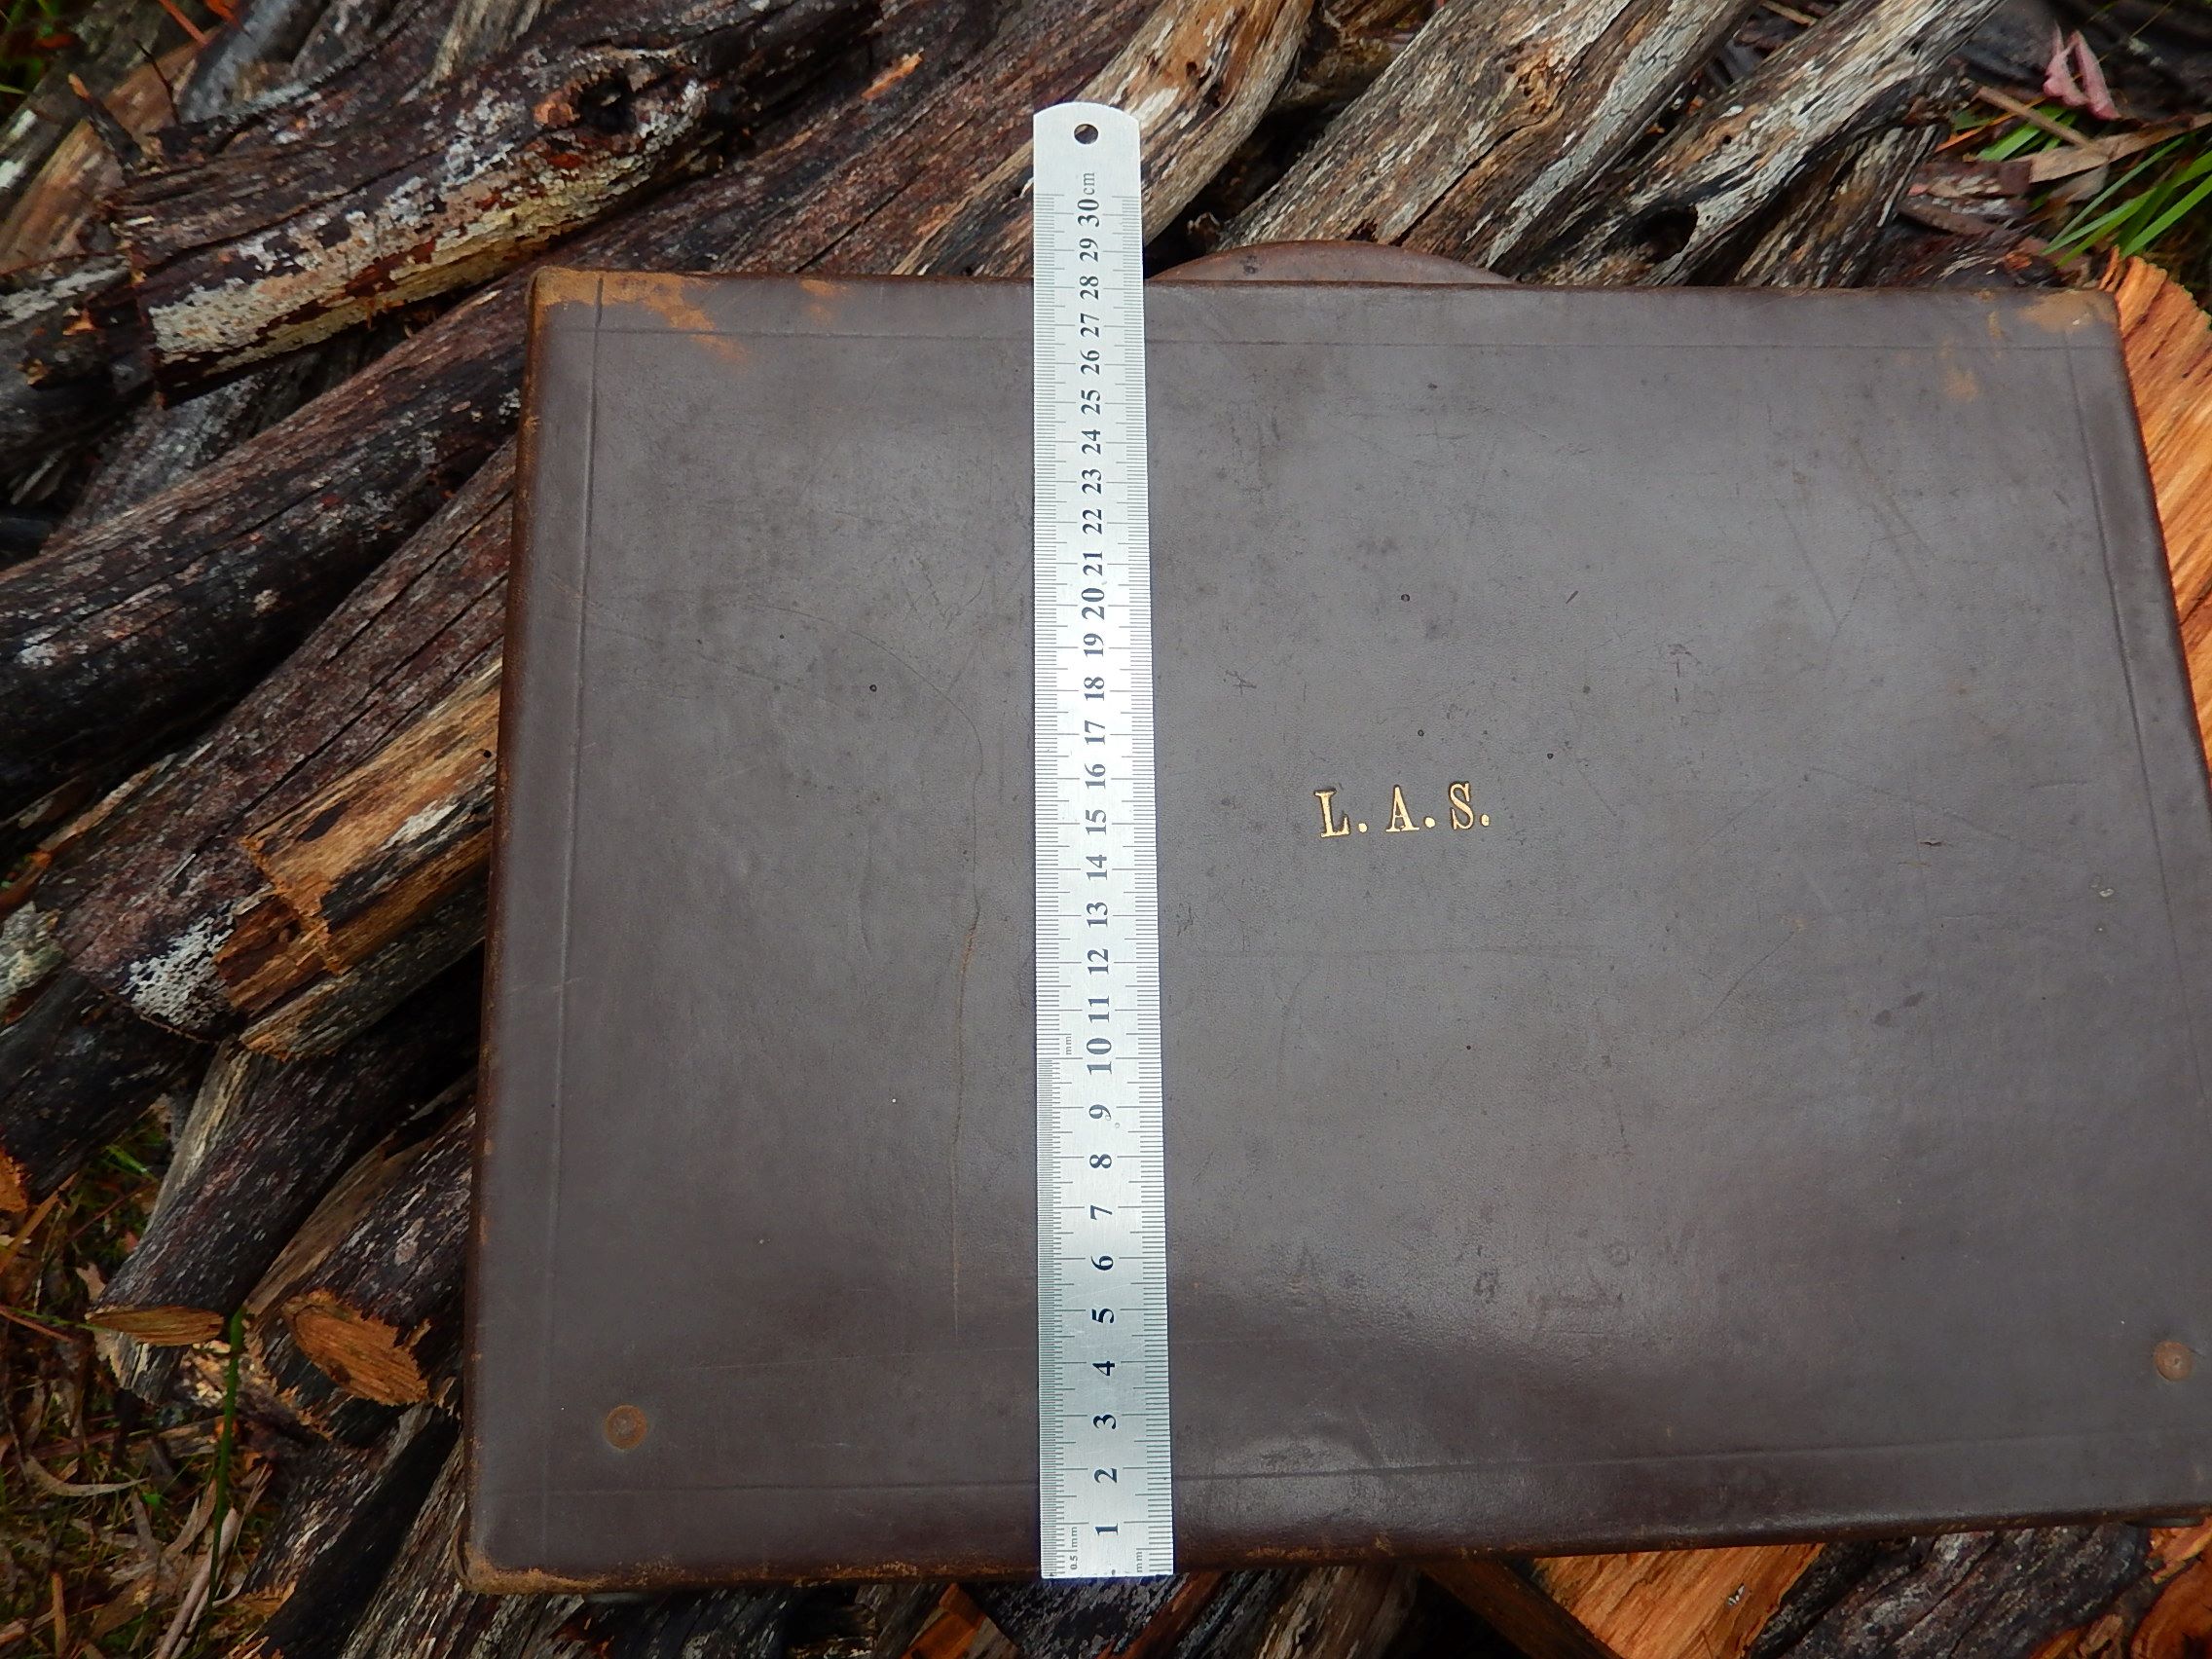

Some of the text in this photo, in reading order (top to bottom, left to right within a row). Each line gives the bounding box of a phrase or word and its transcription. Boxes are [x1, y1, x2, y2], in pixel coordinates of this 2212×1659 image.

[1079, 238, 1099, 263] 29
[1079, 275, 1099, 301] 28
[1080, 313, 1100, 338] 27
[1079, 350, 1100, 376] 26
[1080, 389, 1101, 416] 25
[1081, 428, 1102, 456] 24
[1081, 468, 1102, 495] 23
[1082, 508, 1103, 535] 22
[1082, 550, 1103, 577] 21
[1080, 587, 1105, 621] 20
[1083, 632, 1105, 658] 19
[1083, 676, 1105, 702] 18
[1084, 719, 1106, 746] 17
[1084, 763, 1106, 790] 16
[1085, 809, 1107, 836] 15
[1085, 854, 1108, 881] 14
[1086, 902, 1109, 929] 13
[1087, 948, 1110, 976] 12
[1087, 995, 1110, 1024] 11
[1086, 1037, 1113, 1076] 10
[1088, 1103, 1112, 1122] 9
[1088, 1153, 1113, 1169] 8
[1089, 1204, 1113, 1221] 7
[1089, 1255, 1115, 1272] 6
[1090, 1308, 1115, 1324] 5
[1091, 1360, 1116, 1377] 4
[1092, 1414, 1117, 1430] 3
[1093, 1467, 1118, 1484] 2
[1071, 1526, 1078, 1548] mm
[1094, 1522, 1119, 1537] 1
[1136, 1551, 1143, 1573] mm
